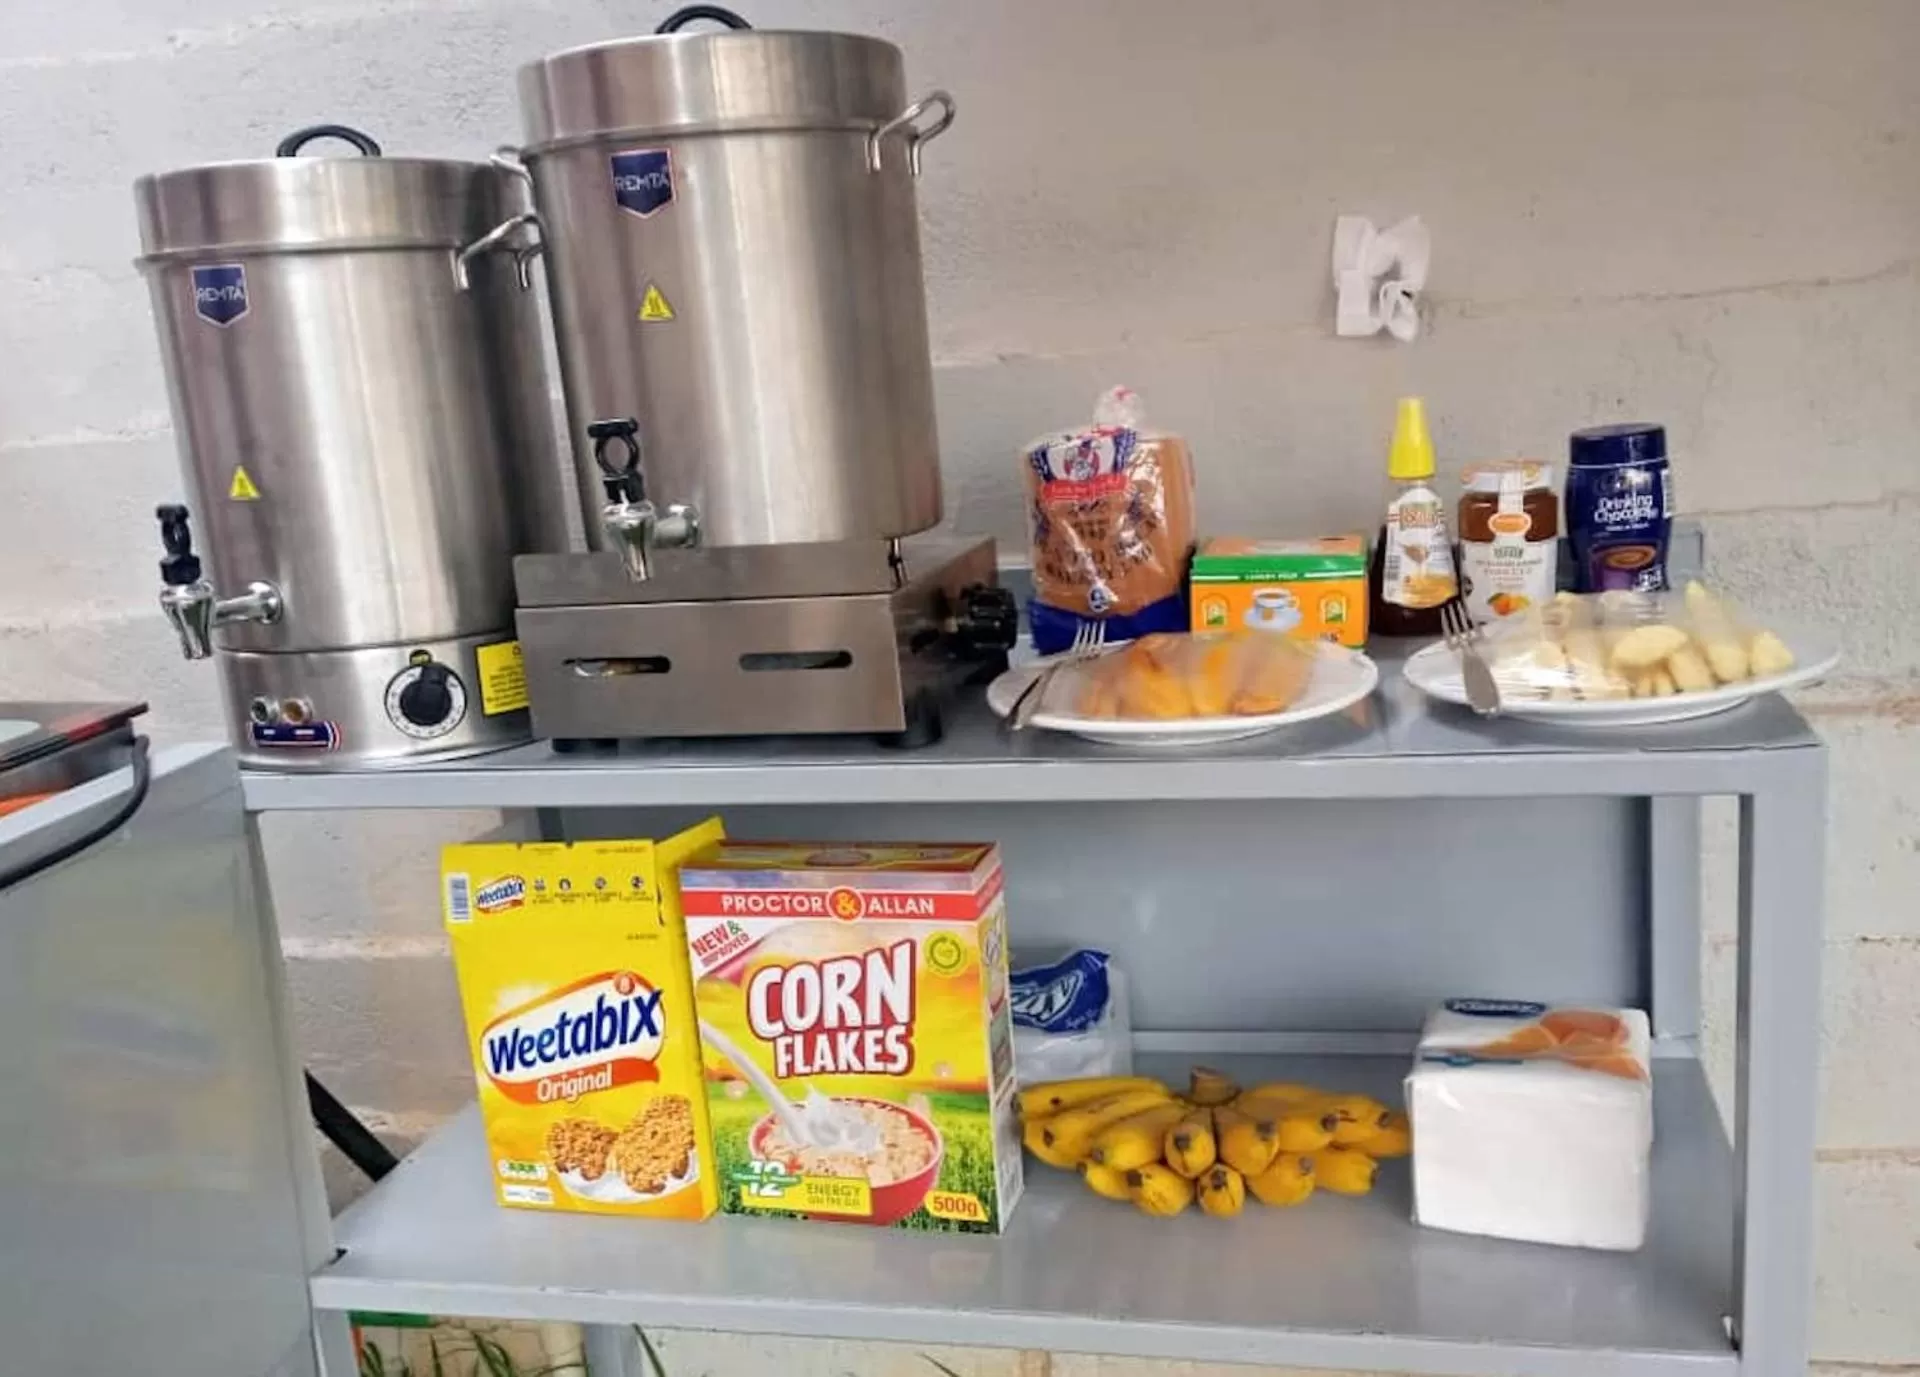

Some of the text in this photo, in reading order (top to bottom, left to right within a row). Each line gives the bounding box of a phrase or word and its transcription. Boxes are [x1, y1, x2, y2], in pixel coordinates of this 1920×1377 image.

[614, 172, 668, 193] REMTA
[196, 285, 245, 302] REMTA
[721, 892, 935, 917] PROCTOR & ALLAN
[691, 920, 743, 956] NEW &
[700, 933, 750, 967] ROVED
[749, 940, 914, 1038] CORN
[489, 989, 664, 1074] Weetabix
[776, 1025, 909, 1077] FLAKES
[536, 1064, 613, 1103] Original
[806, 1183, 863, 1196] ENERGY
[933, 1196, 979, 1218] 500g
